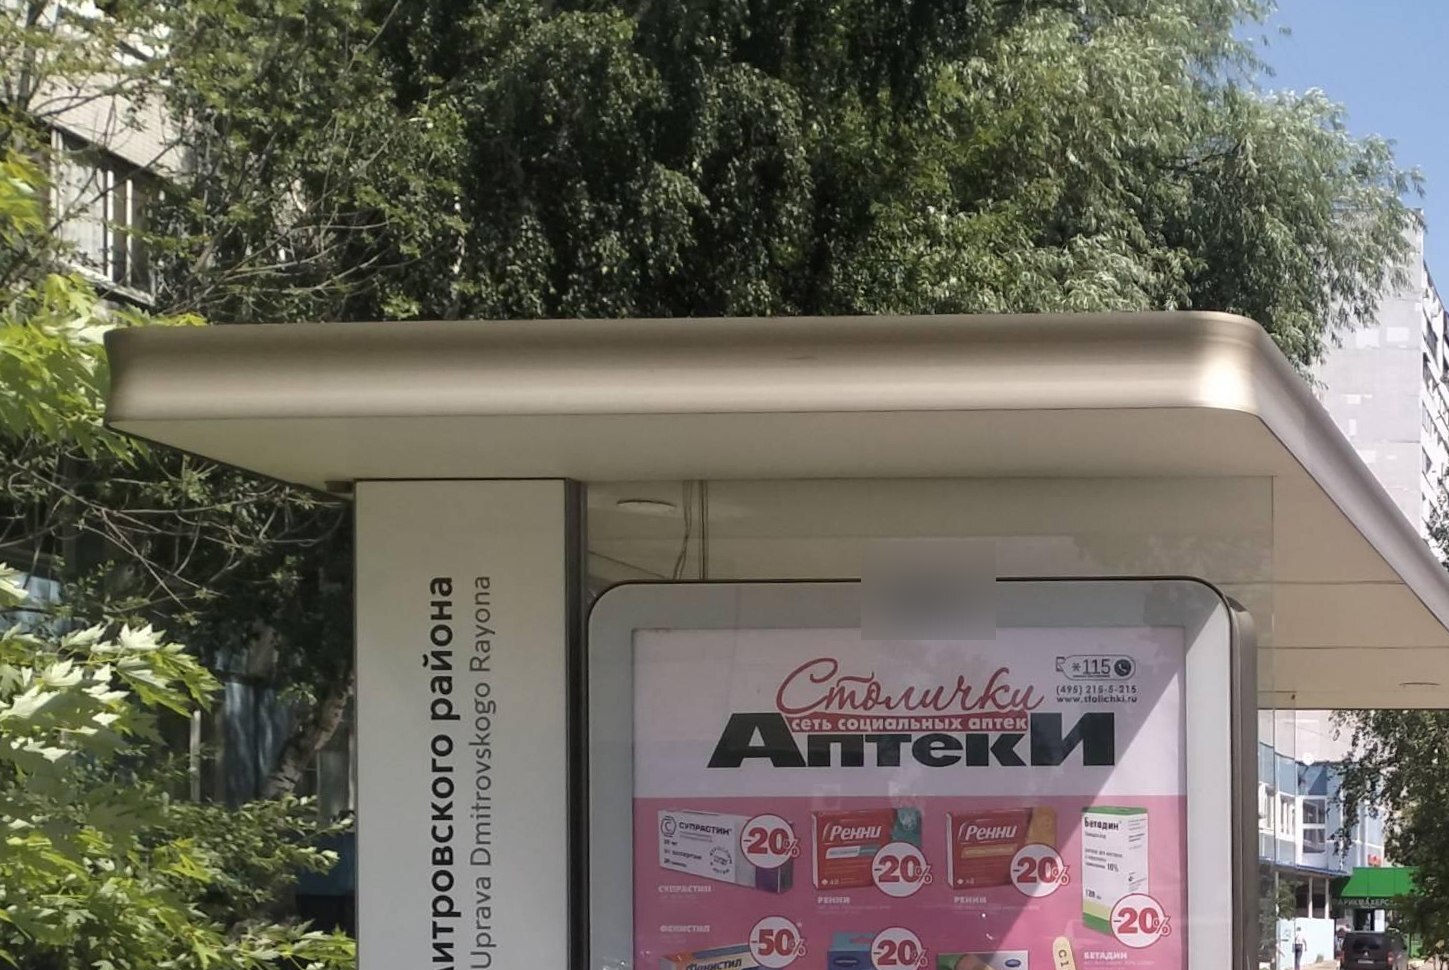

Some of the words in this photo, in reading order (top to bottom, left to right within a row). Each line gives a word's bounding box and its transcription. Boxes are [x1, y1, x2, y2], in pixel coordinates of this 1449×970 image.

[469, 575, 497, 673] Rayona
[422, 576, 461, 720] района
[775, 656, 1044, 713] Столички
[1056, 685, 1083, 696] (495)
[1086, 685, 1137, 694] 215-5-215
[1056, 695, 1138, 703] www.stolichki.ru
[791, 717, 834, 732] сеть
[837, 716, 962, 733] социальных
[968, 716, 1028, 732] аптек
[469, 682, 496, 866] Dmitrovskogo
[679, 821, 730, 836] СУПРАСТИН
[830, 824, 882, 842] Ренни
[965, 824, 1017, 842] Ренни
[470, 877, 497, 969] Uprava
[1084, 951, 1127, 960] БЕТАДИН
